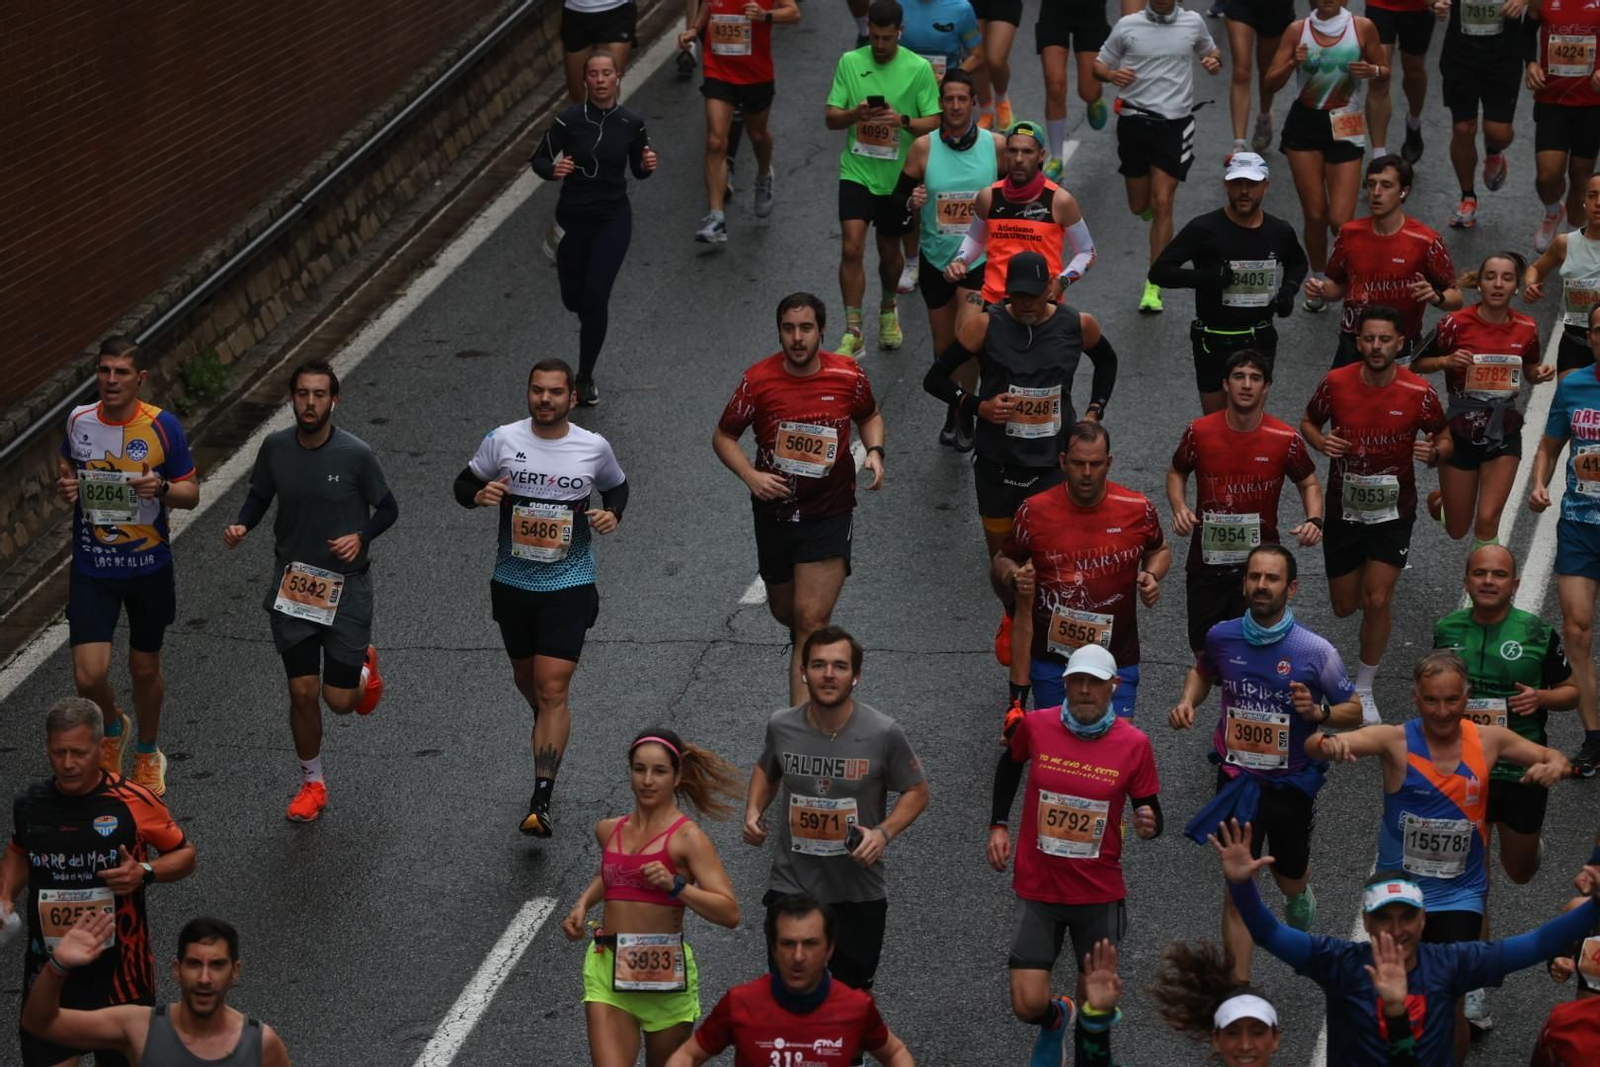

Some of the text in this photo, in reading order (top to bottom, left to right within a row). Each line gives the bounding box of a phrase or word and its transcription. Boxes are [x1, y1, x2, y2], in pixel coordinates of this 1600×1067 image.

[1467, 5, 1495, 17] 7315
[715, 25, 741, 37] 4335
[1555, 46, 1584, 58] 4224
[861, 125, 889, 139] 4099
[945, 203, 975, 216] 4726
[1233, 272, 1265, 286] 8403
[1475, 366, 1508, 382] 5782
[1015, 400, 1050, 416] 4248
[785, 435, 823, 455] 5602
[1003, 475, 1040, 488] SALOMON
[86, 484, 124, 501] 8264
[1350, 486, 1385, 503] 7953
[521, 521, 558, 539] 5486
[1210, 527, 1246, 542] 7954
[289, 576, 326, 599] 5342
[1058, 621, 1096, 643] 5558
[1235, 724, 1273, 744] 3908
[800, 812, 840, 831] 5971
[1047, 808, 1090, 832] 5792
[1410, 831, 1463, 852] 15578
[628, 950, 671, 970] 3933
